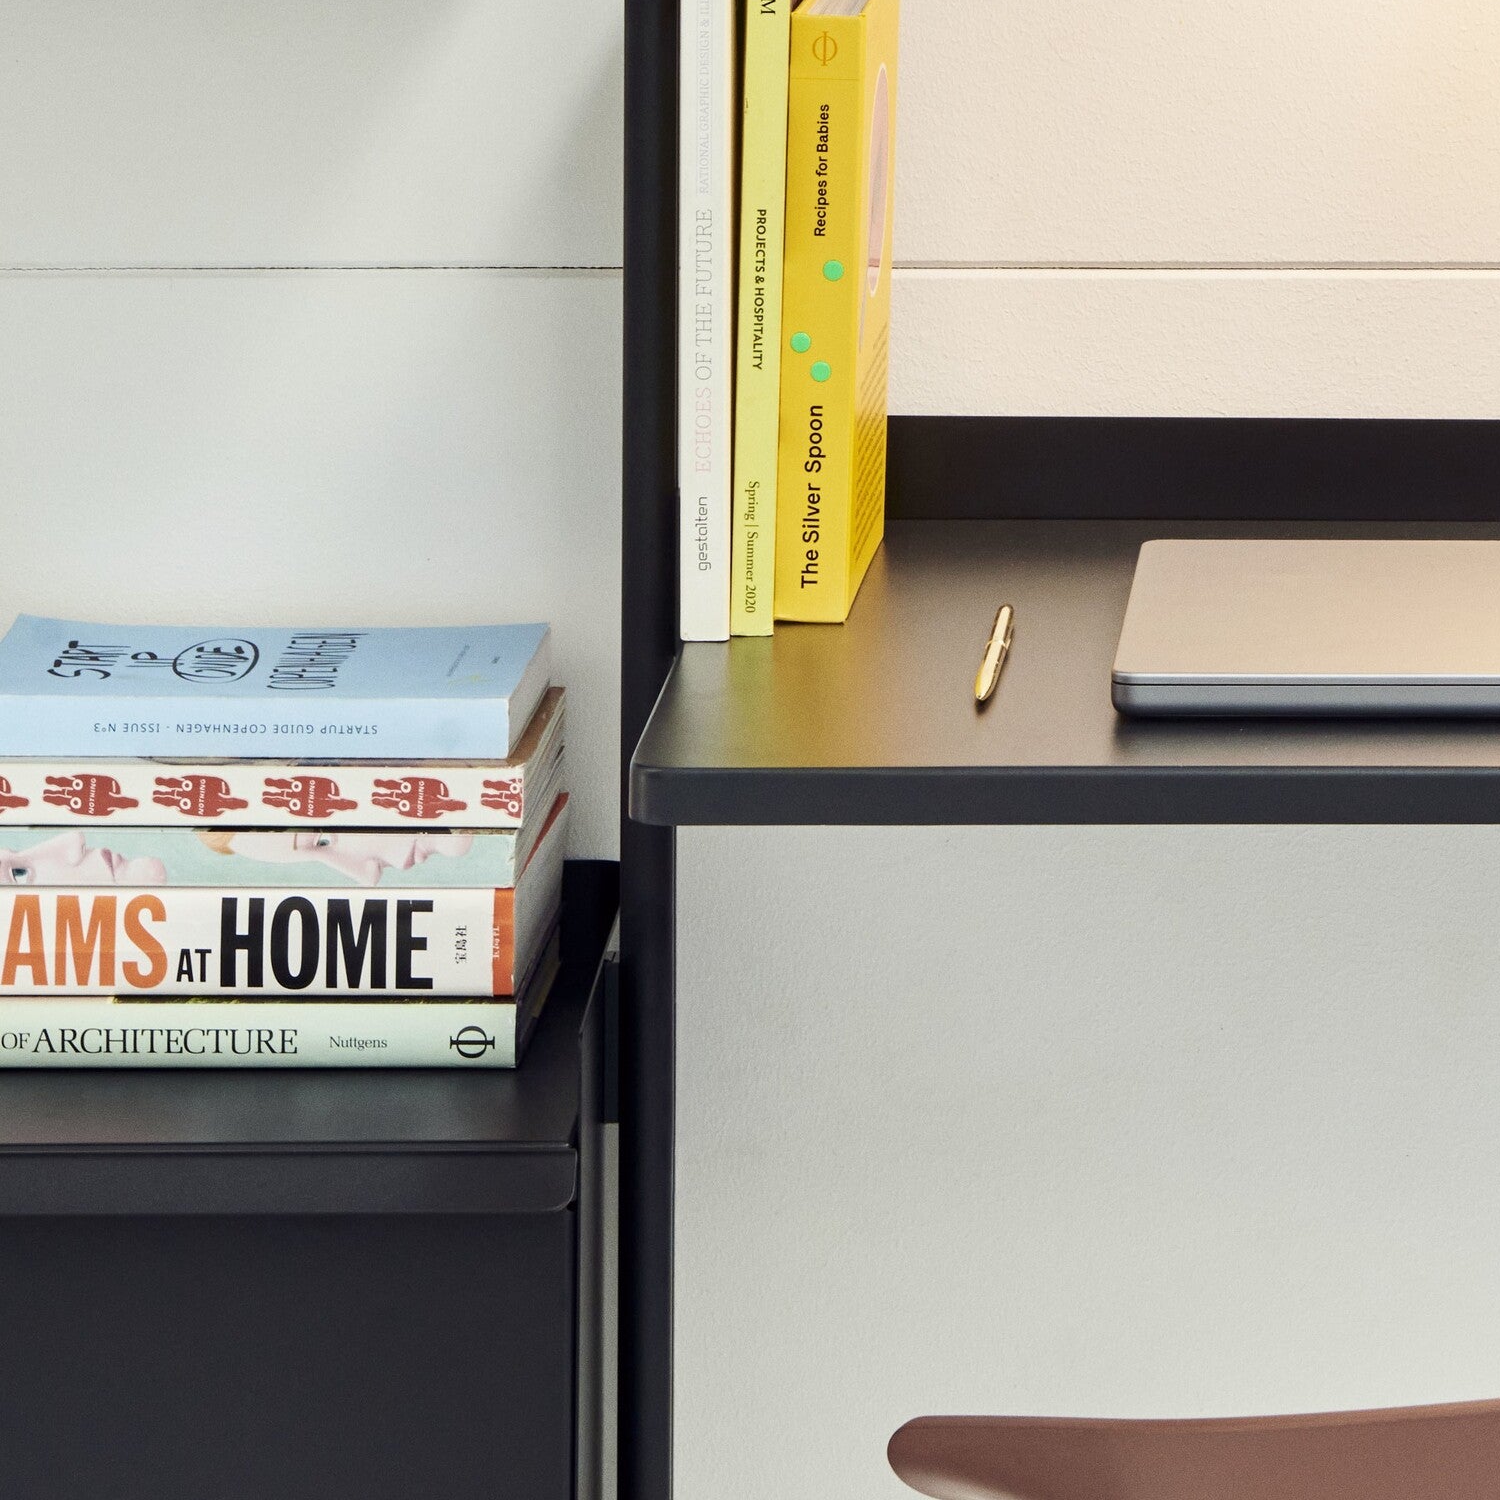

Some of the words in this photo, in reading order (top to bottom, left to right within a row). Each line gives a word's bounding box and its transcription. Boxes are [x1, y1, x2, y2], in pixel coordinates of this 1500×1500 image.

[816, 104, 830, 153] Babies
[815, 156, 828, 177] for
[814, 179, 830, 237] Recipes
[695, 208, 712, 296] FUTURE
[755, 209, 767, 273] PROJECTS
[754, 275, 764, 284] &
[695, 302, 712, 347] THE
[752, 287, 765, 370] HOSPITALITY
[695, 352, 712, 381] OF
[695, 387, 712, 473] ECHOES
[804, 405, 826, 473] Spoon
[744, 480, 760, 521] Spring
[802, 482, 822, 543] Silver
[695, 496, 712, 571] gestalten
[746, 531, 759, 582] Summer
[801, 549, 819, 589] The
[745, 585, 757, 613] 2020
[46, 639, 131, 680] START
[265, 632, 369, 690] COPENHAGEN
[122, 723, 160, 734] ISSUE
[176, 723, 268, 734] COPENHAGEN
[272, 724, 315, 735] GUIDE
[319, 724, 379, 735] STARTUP
[88, 777, 97, 815] NOTHING
[198, 778, 207, 816] NOTHING
[307, 779, 316, 816] NOTHING
[416, 780, 425, 817] NOTHING
[1, 894, 169, 989] AMS
[176, 948, 213, 983] AT
[219, 896, 434, 990] HOME
[1, 1032, 31, 1050] OF
[31, 1027, 299, 1055] ARCHITECTURE
[328, 1034, 388, 1051] Nuttgens
